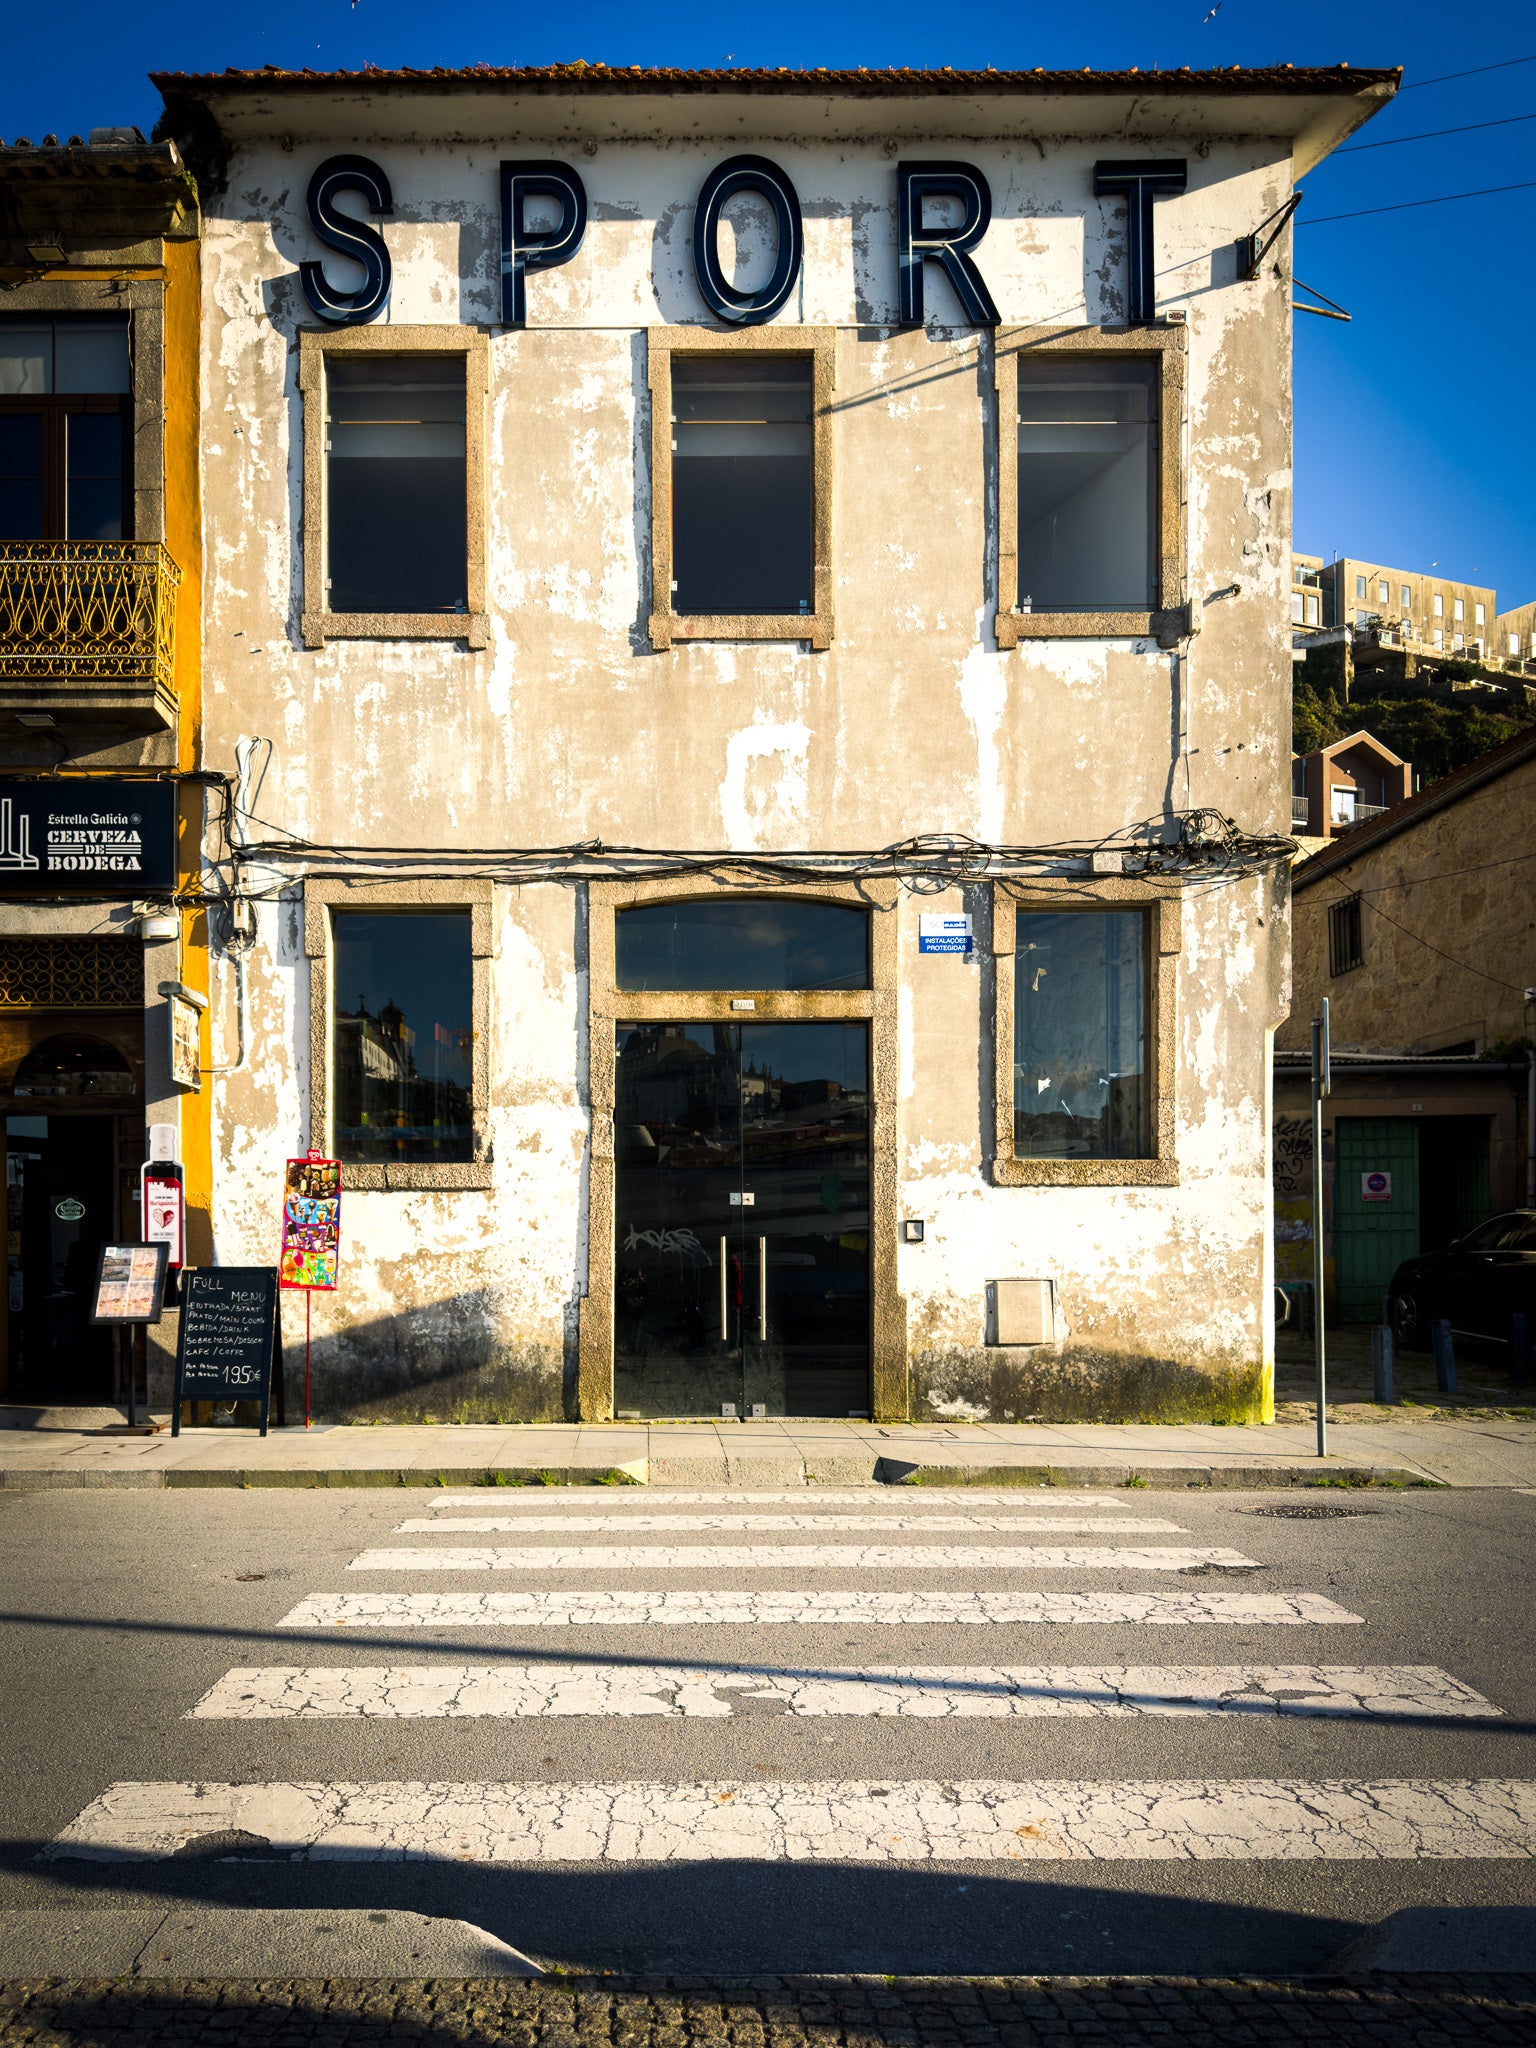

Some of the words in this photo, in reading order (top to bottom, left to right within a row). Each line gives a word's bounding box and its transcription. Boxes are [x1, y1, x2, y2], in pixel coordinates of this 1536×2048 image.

[300, 154, 1187, 327] SPORT
[47, 813, 88, 825] Estrella
[90, 812, 128, 825] Galicia
[47, 830, 142, 843] CERVEZA
[84, 844, 105, 855] DE
[47, 855, 142, 871] BODEGA
[192, 1276, 224, 1291] FULL
